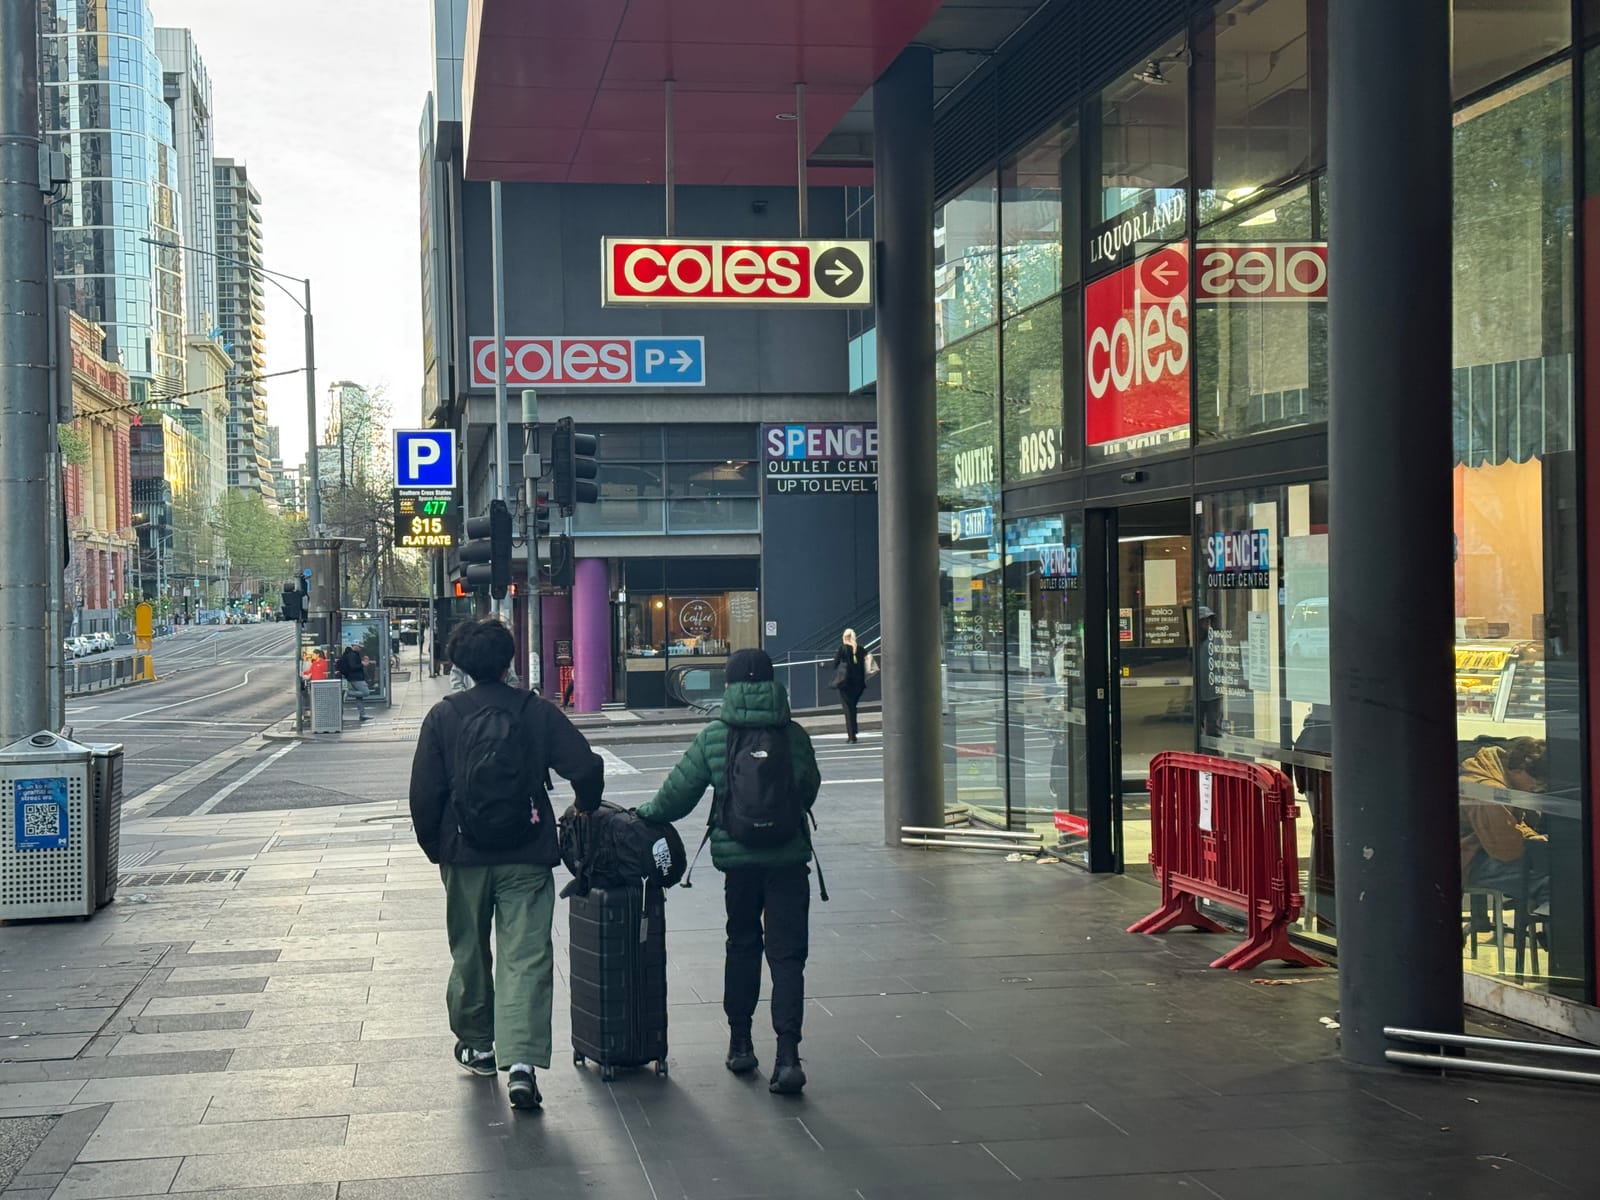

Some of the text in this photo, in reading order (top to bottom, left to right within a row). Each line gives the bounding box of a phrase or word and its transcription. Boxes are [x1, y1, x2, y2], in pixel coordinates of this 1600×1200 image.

[1090, 195, 1185, 262] LIQUORLAND
[624, 245, 801, 294] coles
[1087, 288, 1189, 399] coles
[477, 340, 665, 380] coles P
[408, 438, 440, 479] P
[768, 460, 830, 473] OUTLET
[777, 479, 797, 492] UP
[800, 479, 820, 492] TO
[824, 479, 869, 492] LEVEL
[423, 501, 447, 515] 477
[411, 516, 442, 534] $15
[965, 508, 986, 537] ENTRY
[403, 536, 452, 546] FLAT RATE
[1207, 532, 1269, 568] SPENCER
[1040, 546, 1078, 574] SPENCER
[1207, 572, 1269, 587] OUTLET CENTRE
[683, 611, 713, 626] Coffee
